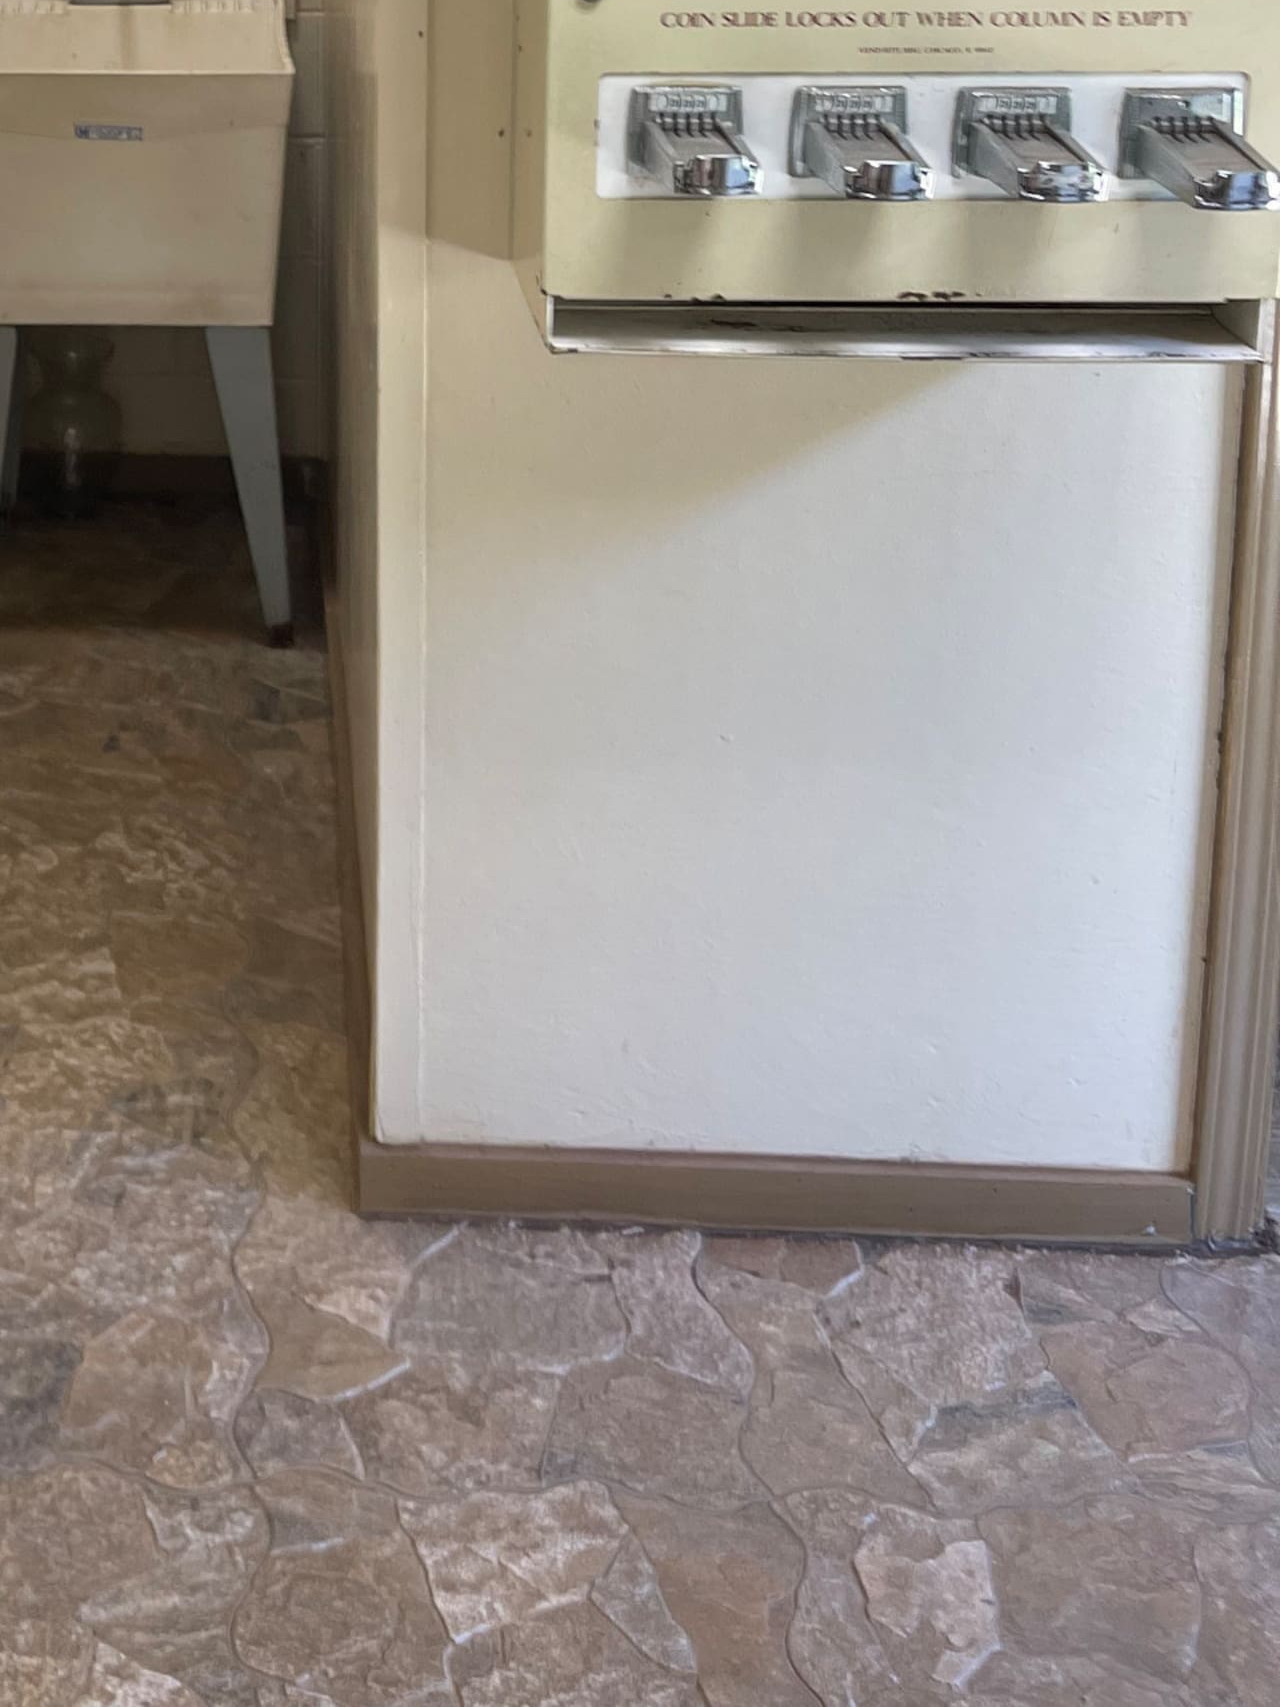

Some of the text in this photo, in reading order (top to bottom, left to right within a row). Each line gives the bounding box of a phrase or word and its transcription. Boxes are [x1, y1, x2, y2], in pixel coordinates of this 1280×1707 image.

[660, 10, 1192, 28] COIN SLIDE LOCKS OUT WHEN COLUMN IS EMPTY
